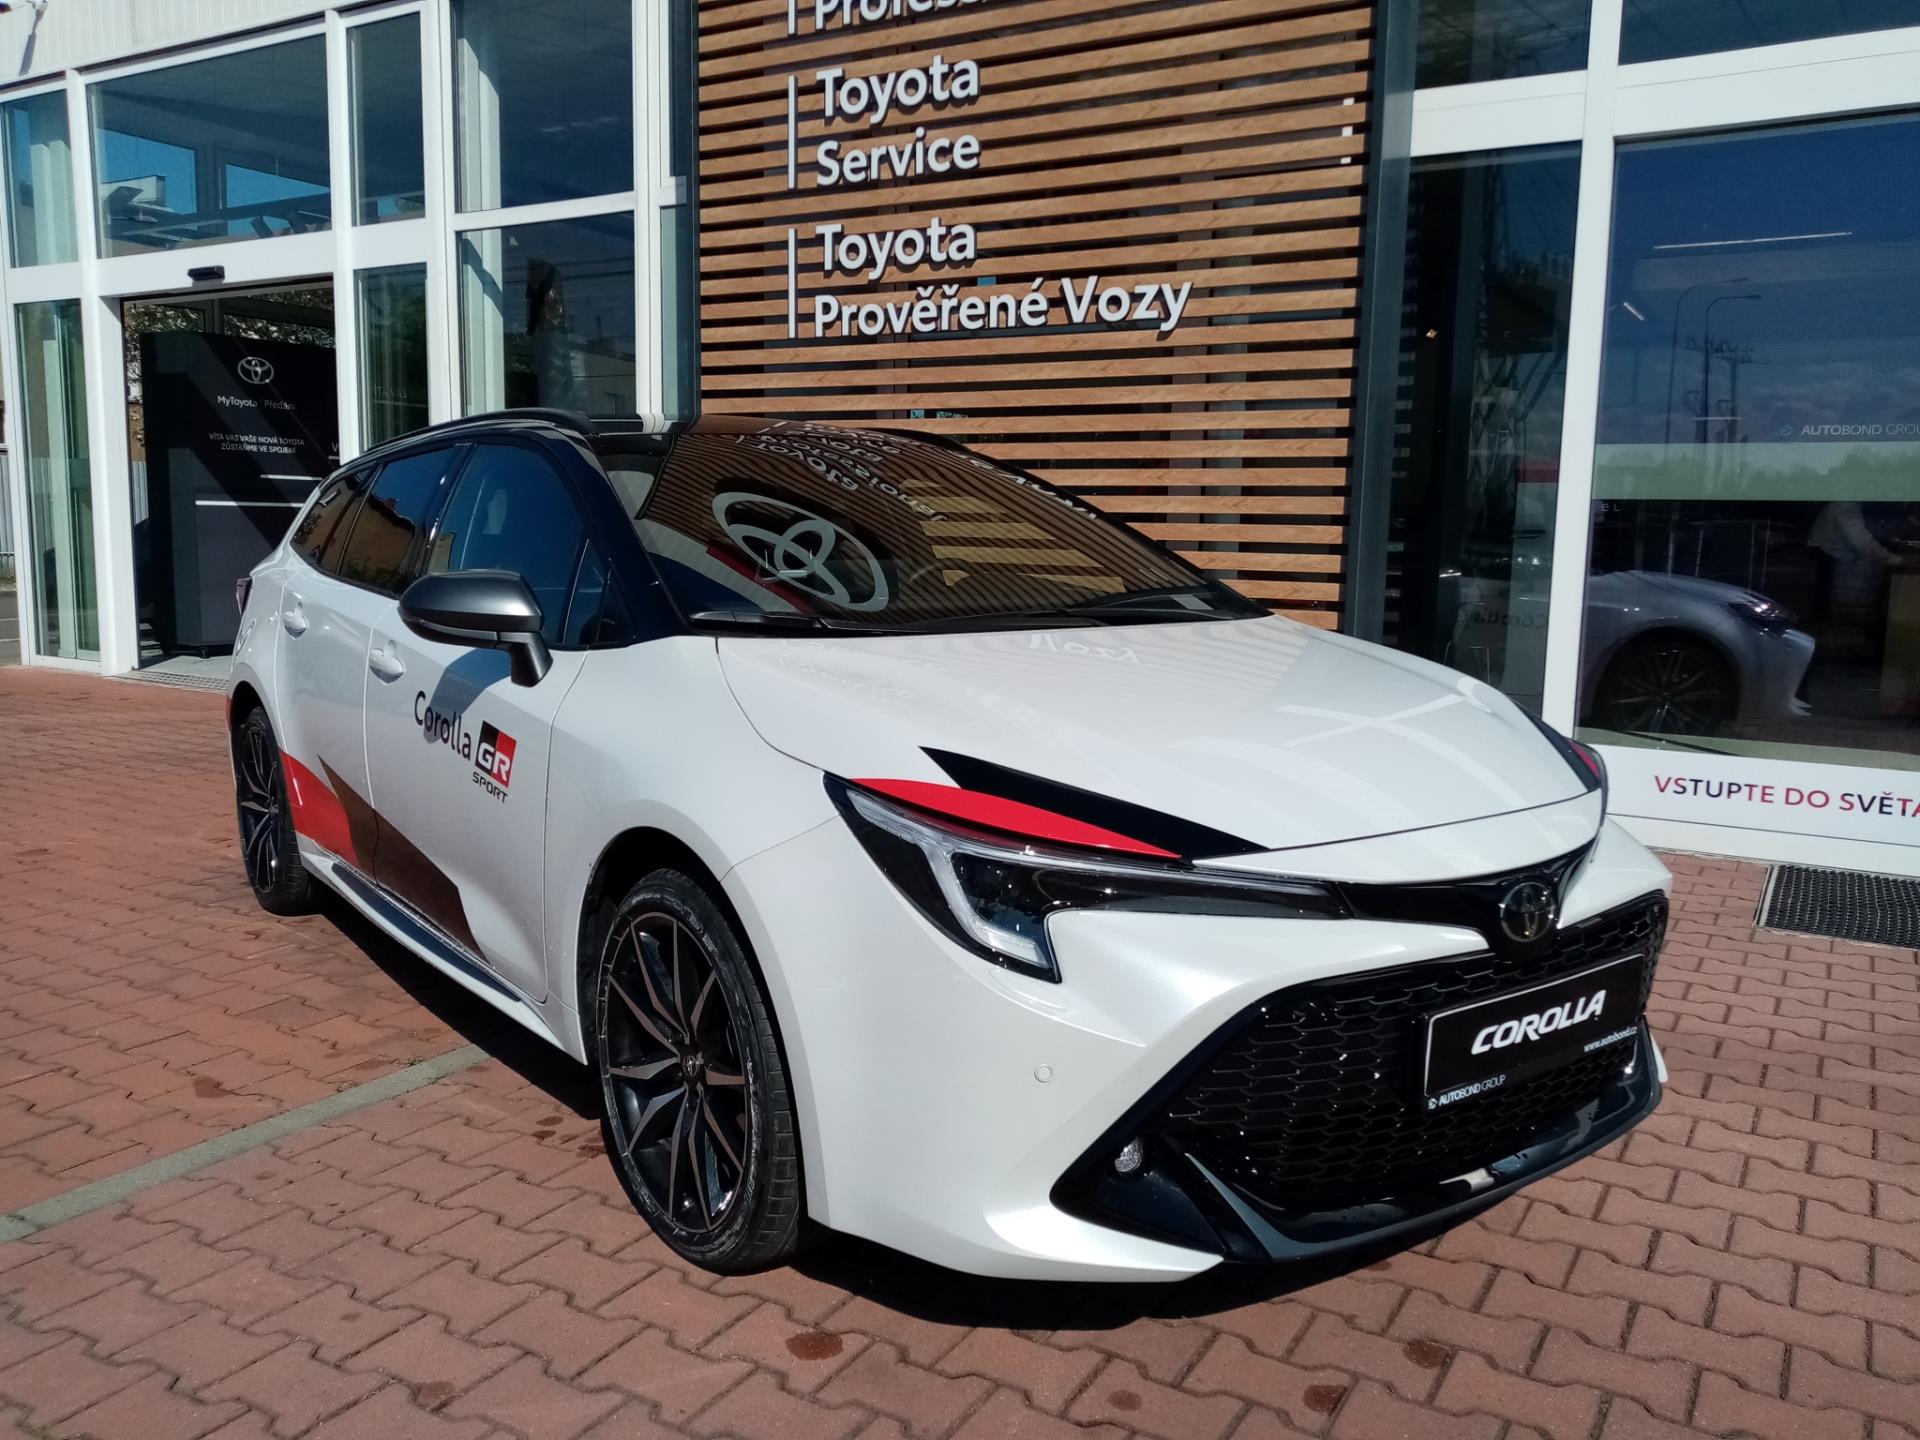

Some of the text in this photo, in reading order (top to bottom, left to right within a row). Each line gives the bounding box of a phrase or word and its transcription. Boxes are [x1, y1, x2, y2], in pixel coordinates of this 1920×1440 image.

[815, 54, 979, 124] Toyota
[816, 126, 981, 186] Service
[815, 216, 976, 280] Toyota
[815, 275, 1193, 338] Prověřené Vozy
[217, 395, 258, 408] MyToyota
[1800, 424, 1882, 436] AUTOBOND
[414, 690, 472, 761] Corolla
[471, 771, 508, 804] SPORT
[477, 741, 511, 783] GR
[1654, 775, 1775, 804] VSTUPTE
[1784, 787, 1830, 808] DO
[1471, 989, 1607, 1055] COROLLA
[1438, 1074, 1506, 1107] AUTOBOND GROUP
